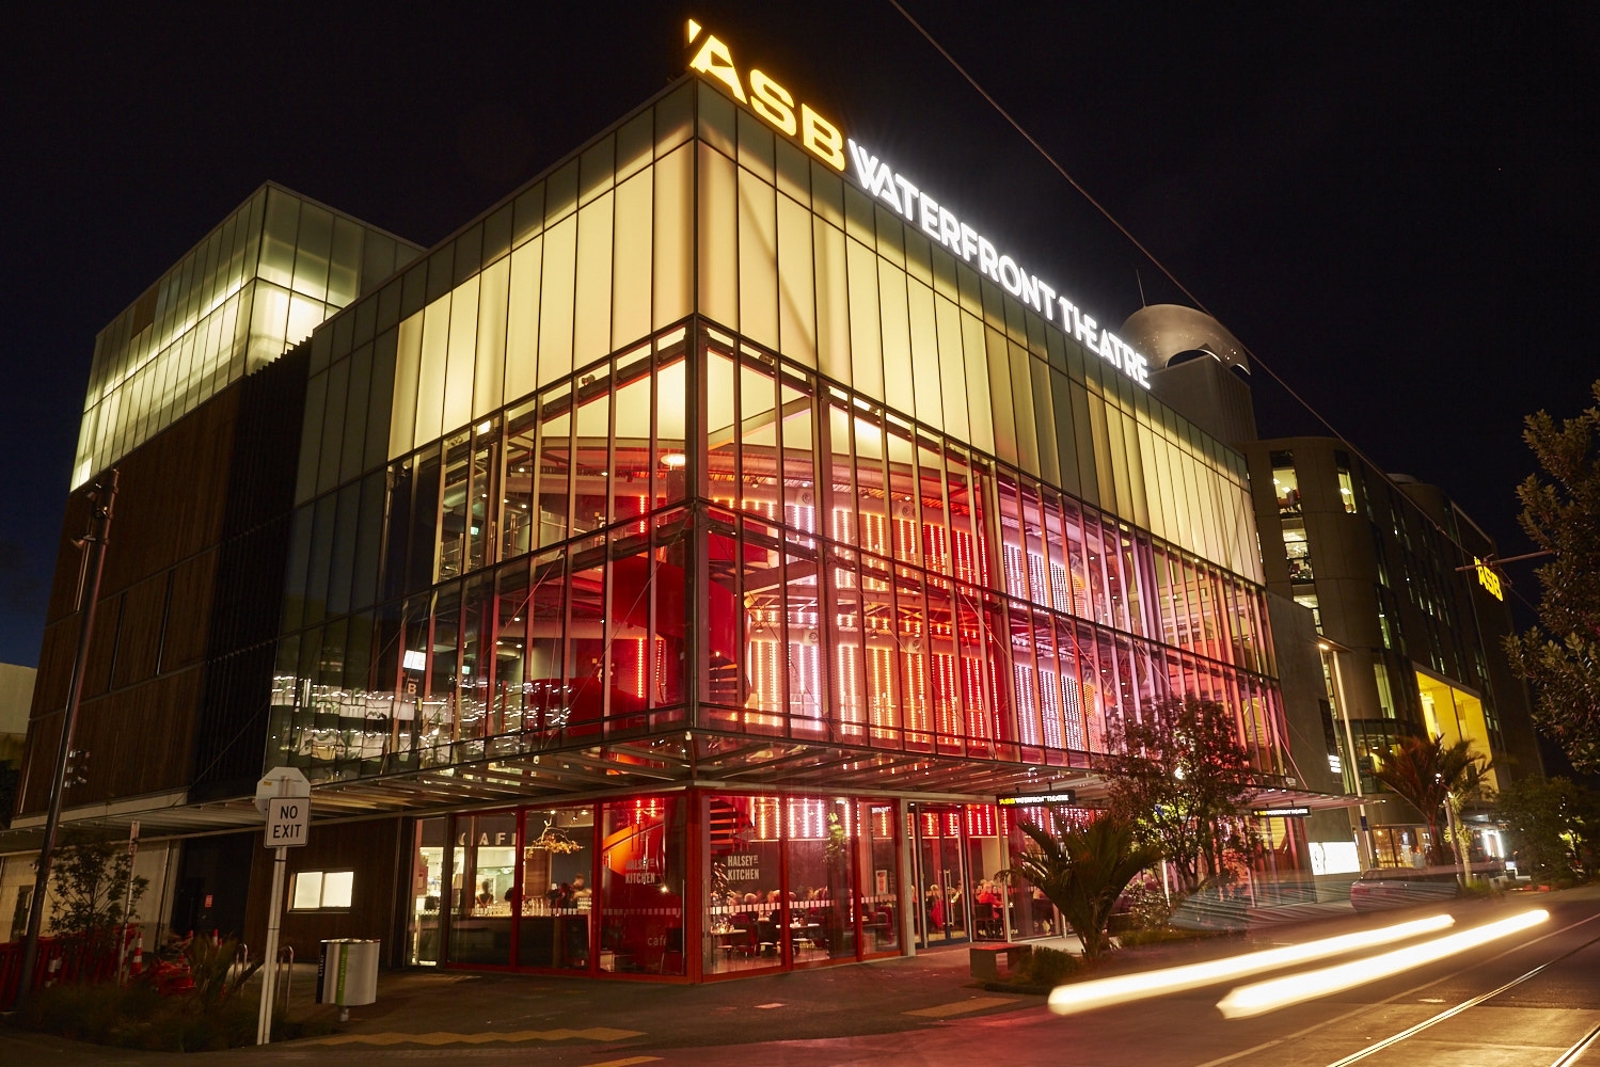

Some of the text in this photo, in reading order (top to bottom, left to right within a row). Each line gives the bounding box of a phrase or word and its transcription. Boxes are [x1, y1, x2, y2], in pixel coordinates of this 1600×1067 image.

[688, 18, 1151, 390] ASB WATERFRONT THEATRE
[1473, 555, 1504, 602] ASB
[280, 805, 298, 819] NO
[273, 824, 302, 839] EXIT
[727, 855, 753, 867] HALSEY
[727, 868, 760, 881] KITCHEN
